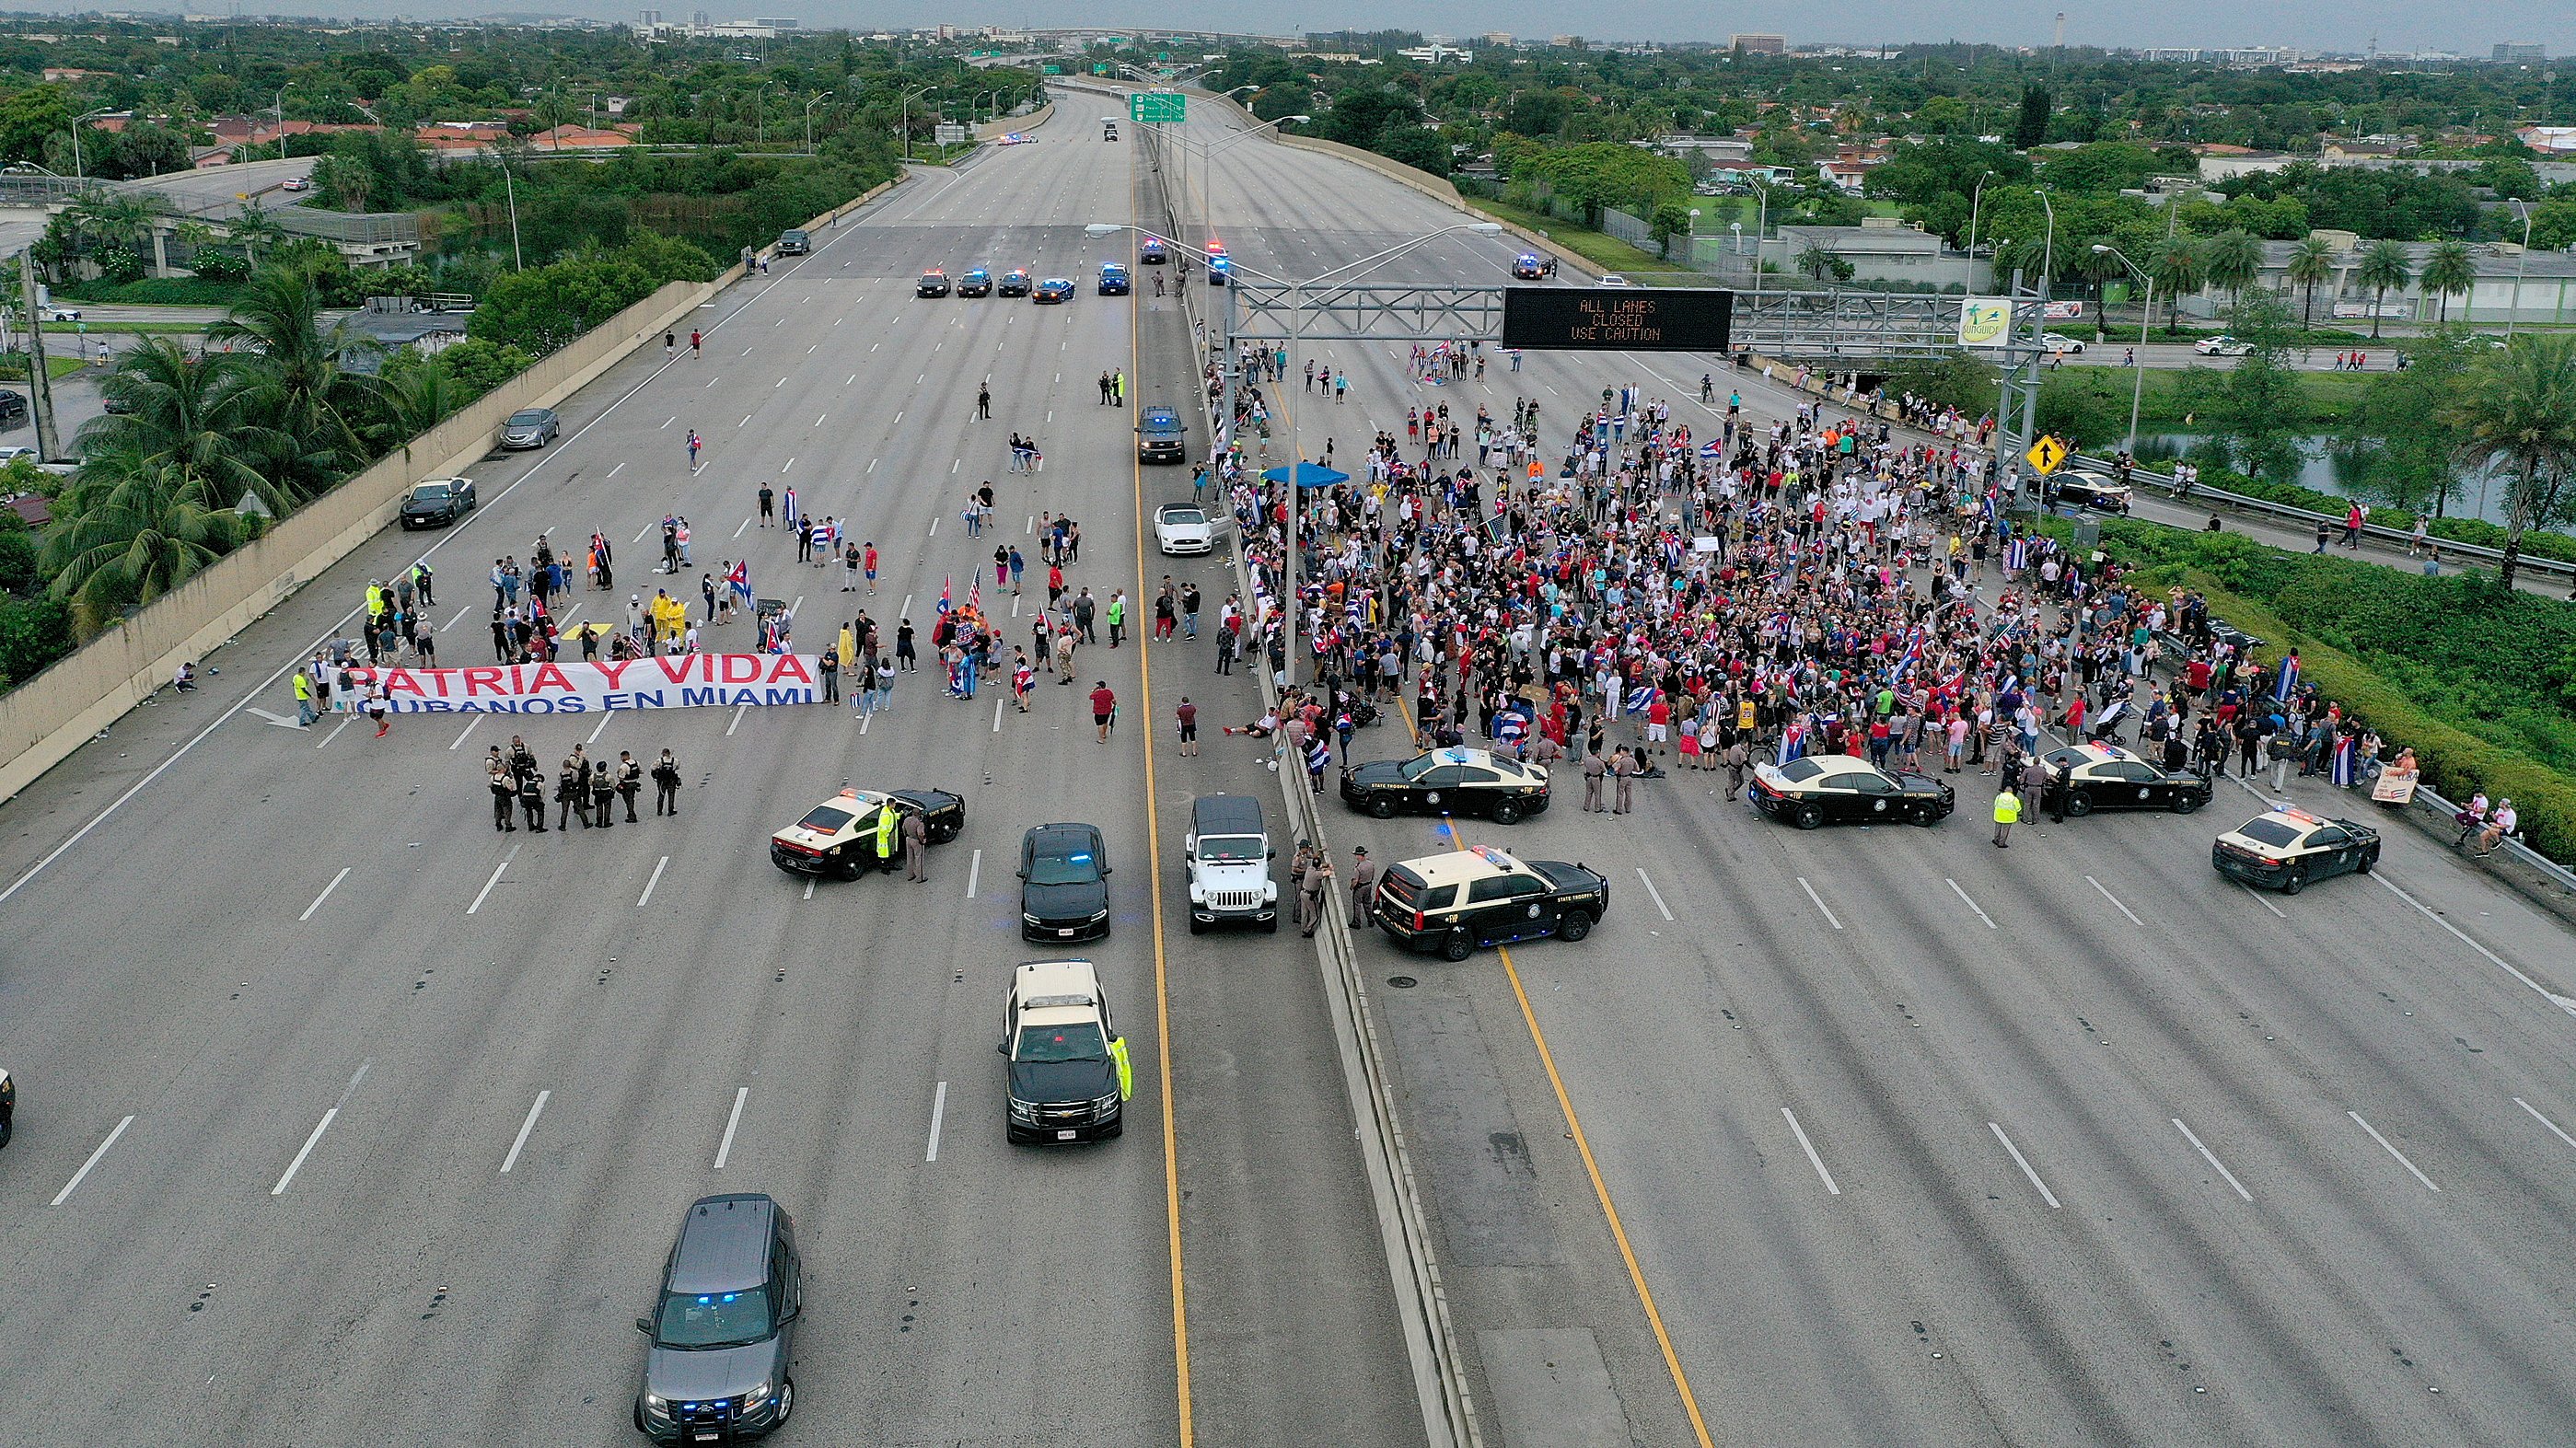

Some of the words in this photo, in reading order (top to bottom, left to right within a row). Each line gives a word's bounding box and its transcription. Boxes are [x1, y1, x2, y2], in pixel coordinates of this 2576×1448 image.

[1580, 299, 1605, 313] ALL
[1614, 300, 1656, 313] LANES
[1593, 313, 1643, 327] CLOSED
[1572, 326, 1597, 340] USE
[1605, 327, 1661, 341] CAUTION
[1963, 324, 1999, 335] SUNGUIDE
[589, 660, 632, 690] Y
[654, 654, 812, 684] VIDA
[603, 690, 665, 711] EN
[682, 687, 812, 707] MIAMI
